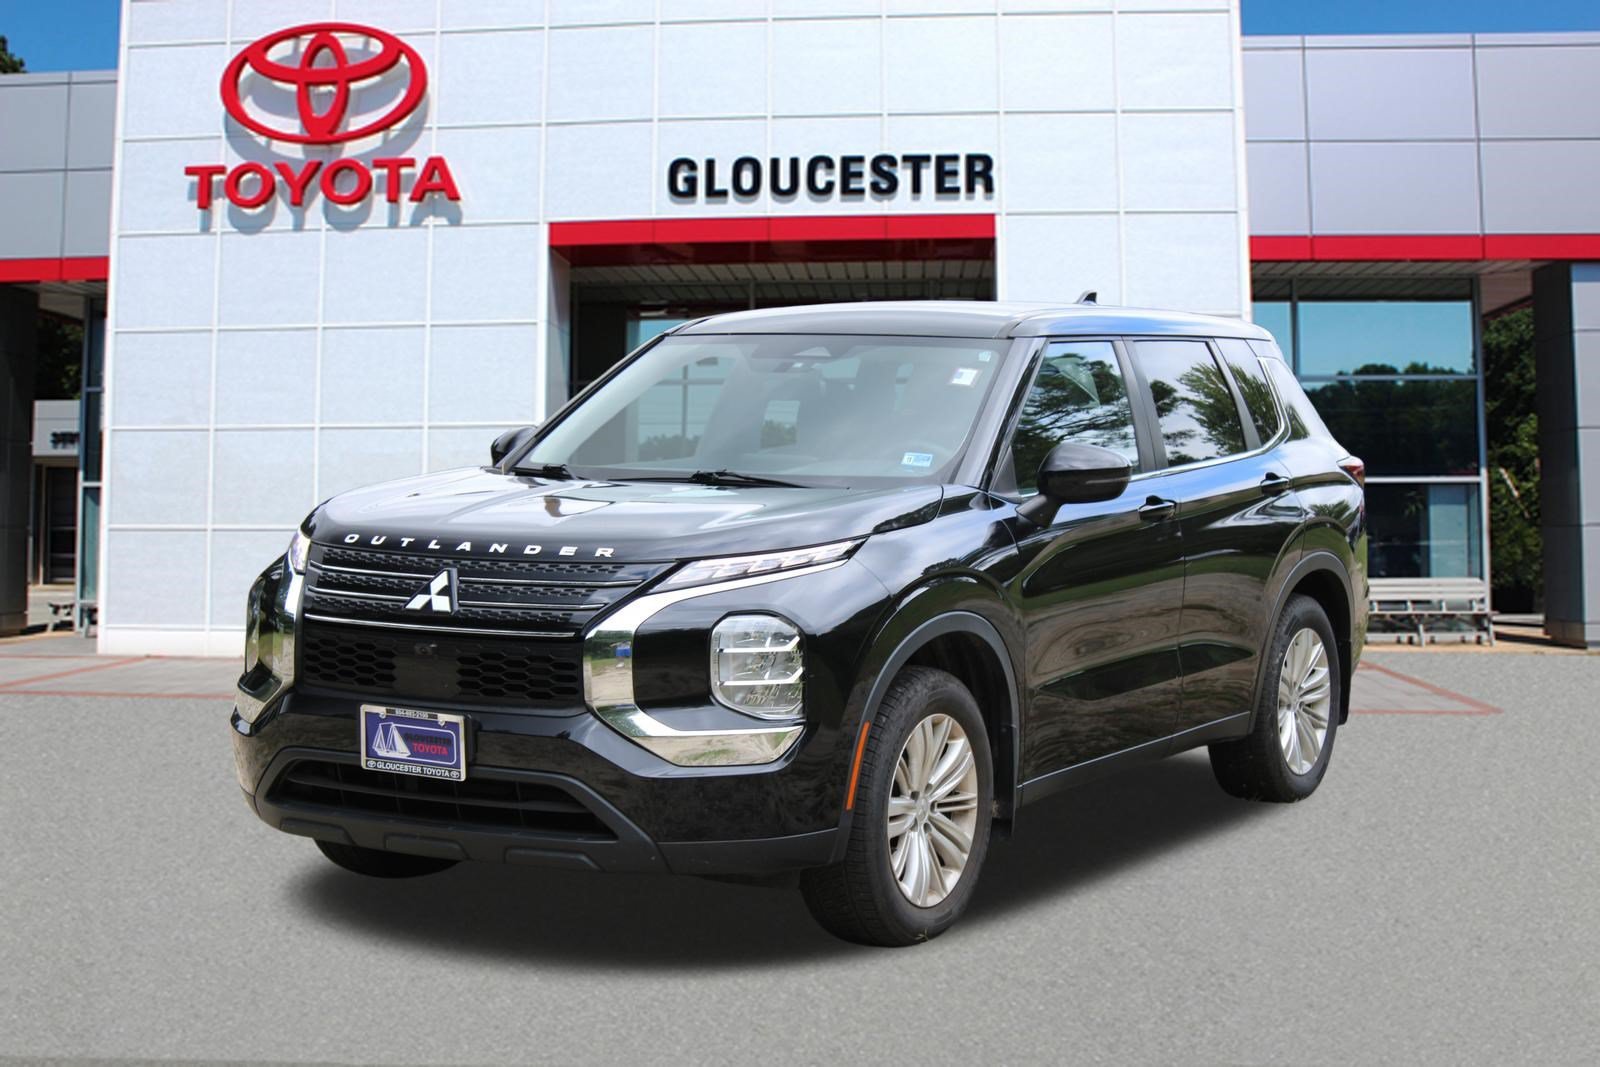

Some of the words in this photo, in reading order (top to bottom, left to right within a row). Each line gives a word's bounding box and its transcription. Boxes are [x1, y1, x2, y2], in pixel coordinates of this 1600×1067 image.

[184, 156, 461, 210] TOYOTA
[667, 153, 994, 198] GLOUCESTER
[344, 533, 615, 558] OUTLANDER
[412, 741, 449, 755] TOYOTA
[376, 761, 422, 774] GLOUCESTER
[423, 767, 450, 777] TOYOTA
